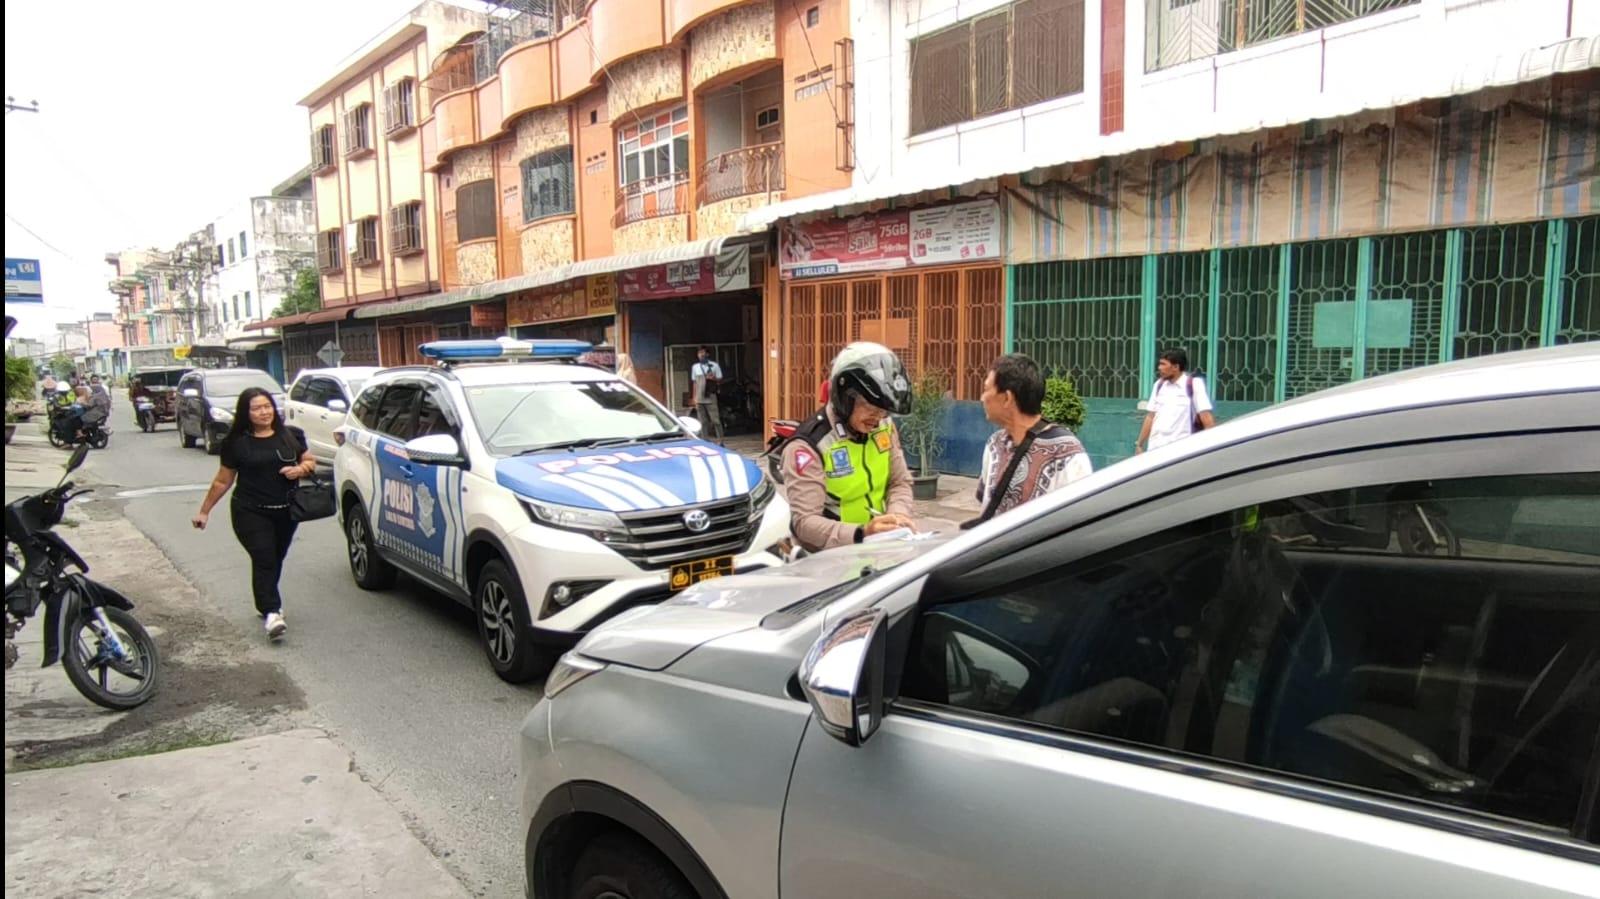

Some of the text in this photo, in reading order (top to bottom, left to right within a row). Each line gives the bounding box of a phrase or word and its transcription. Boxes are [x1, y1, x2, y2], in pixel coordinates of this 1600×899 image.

[879, 223, 908, 238] 75GB
[913, 228, 932, 240] 2GB
[537, 446, 720, 475] POLISI
[384, 478, 414, 514] POLISI
